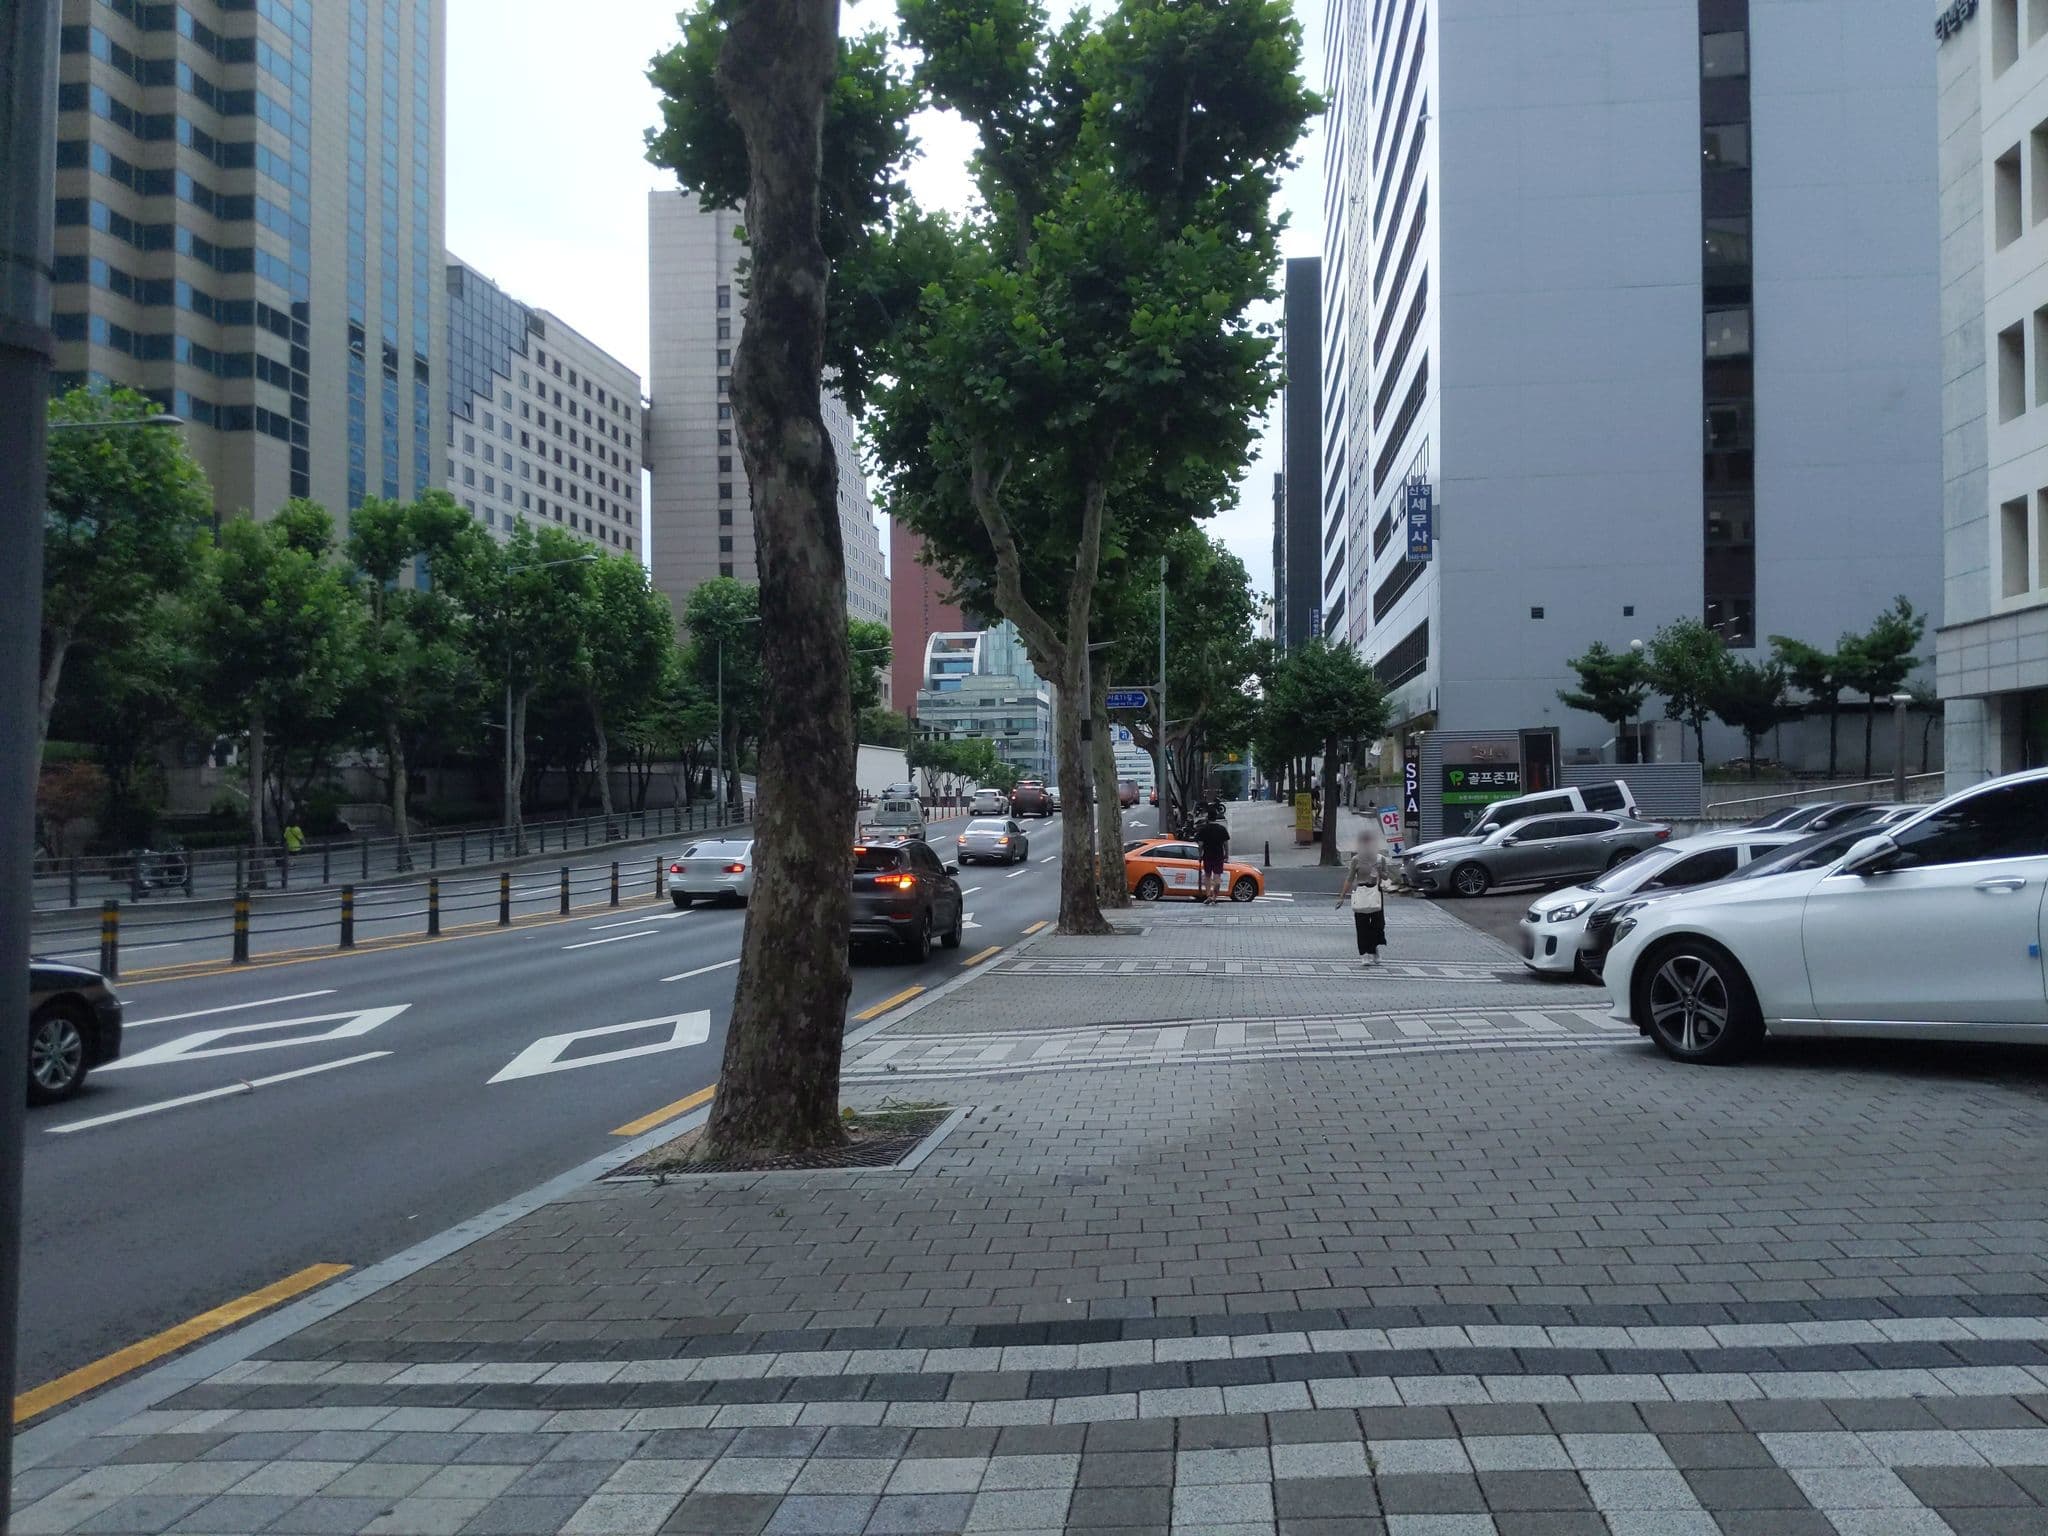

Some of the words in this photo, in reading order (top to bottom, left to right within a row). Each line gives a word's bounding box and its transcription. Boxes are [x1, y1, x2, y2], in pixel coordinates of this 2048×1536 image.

[1411, 497, 1428, 544] 세무사
[1406, 762, 1418, 813] SPA
[1383, 812, 1399, 832] 약
